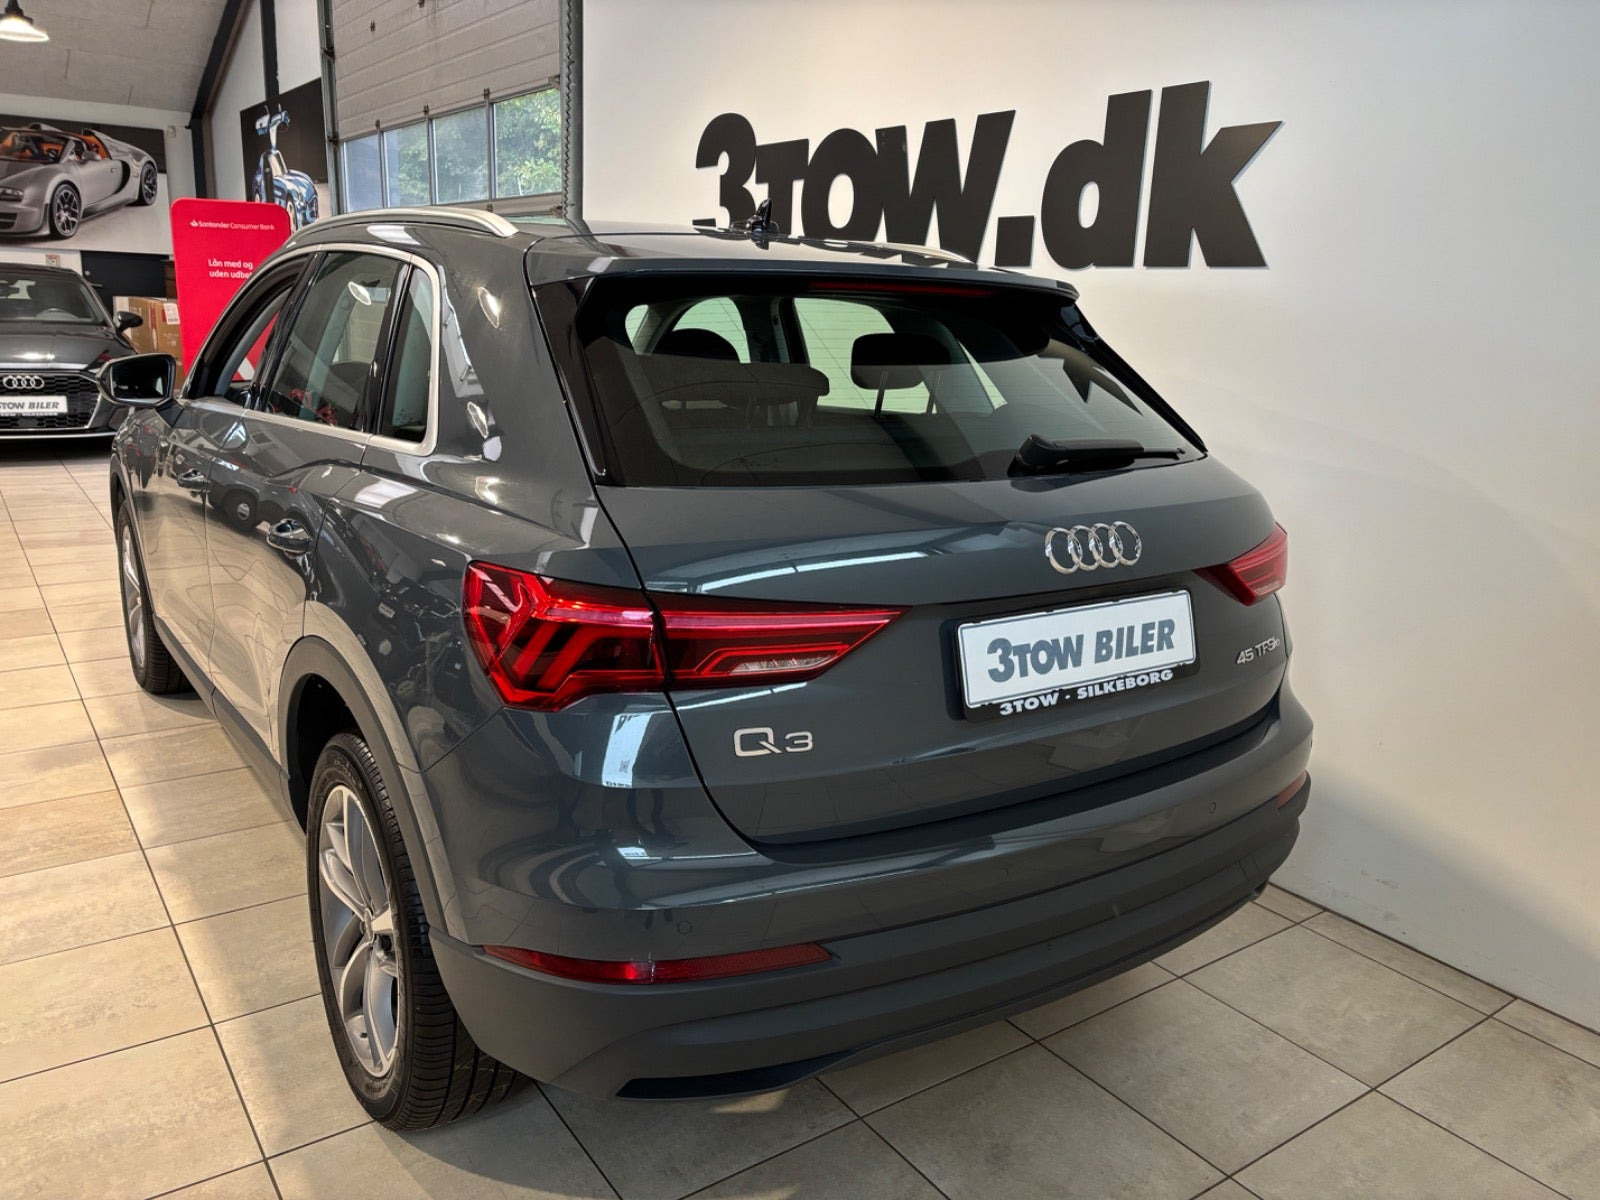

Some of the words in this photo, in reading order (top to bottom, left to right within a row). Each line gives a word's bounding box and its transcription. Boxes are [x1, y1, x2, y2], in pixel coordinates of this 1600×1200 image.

[198, 220, 229, 228] Santander
[230, 222, 259, 230] Consumer
[208, 258, 223, 267] Lån
[224, 259, 242, 268] med
[243, 262, 253, 270] og
[209, 270, 230, 278] uden
[0, 401, 25, 409] TOW
[28, 401, 59, 409] BILER
[986, 633, 1085, 683] 3TOW
[1094, 618, 1175, 664] BILER
[1236, 647, 1255, 665] 45
[999, 692, 1058, 716] 3TOW
[1076, 669, 1174, 699] SILKEBORG
[733, 727, 813, 757] Q3
